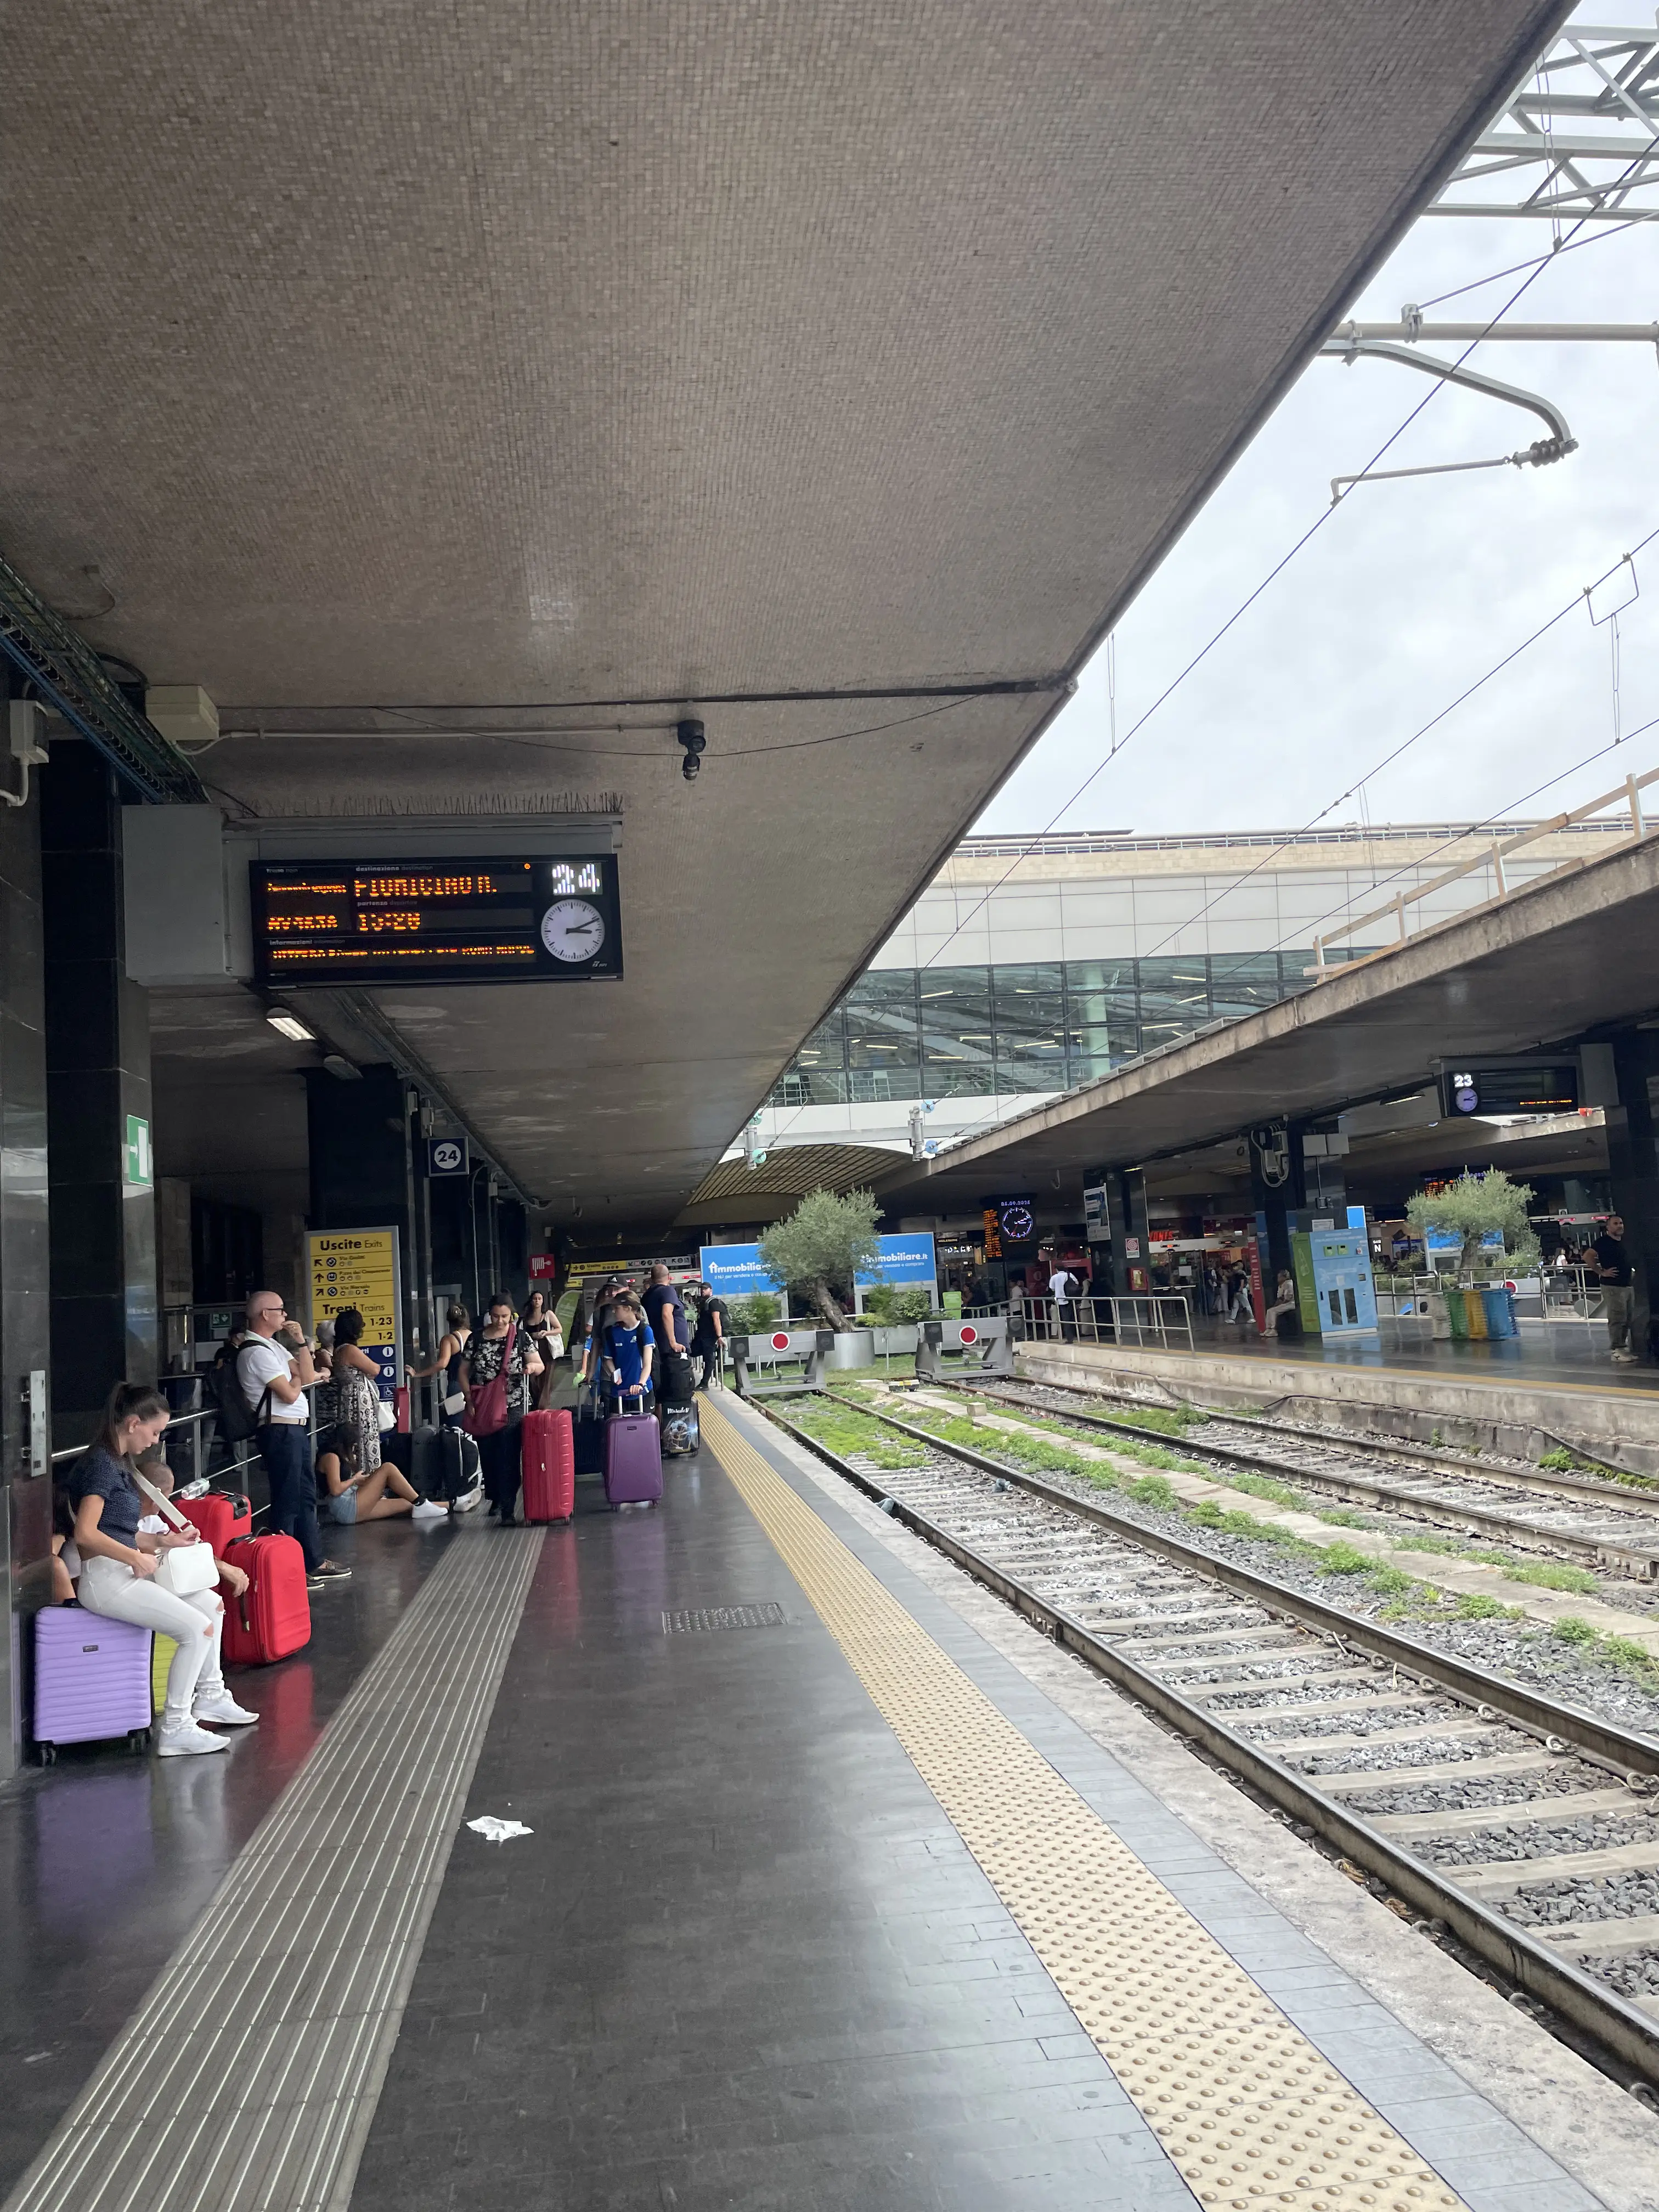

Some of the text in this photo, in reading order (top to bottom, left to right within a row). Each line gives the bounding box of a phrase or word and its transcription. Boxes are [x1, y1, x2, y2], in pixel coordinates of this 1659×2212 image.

[552, 864, 600, 893] 24
[1454, 1074, 1474, 1088] 23
[437, 1149, 458, 1163] 24
[320, 1239, 383, 1251] Uscite Exits
[1374, 1244, 1381, 1252] N
[323, 1302, 385, 1314] Treni Trains
[370, 1317, 393, 1327] 1-23
[378, 1331, 393, 1341] 1-2
